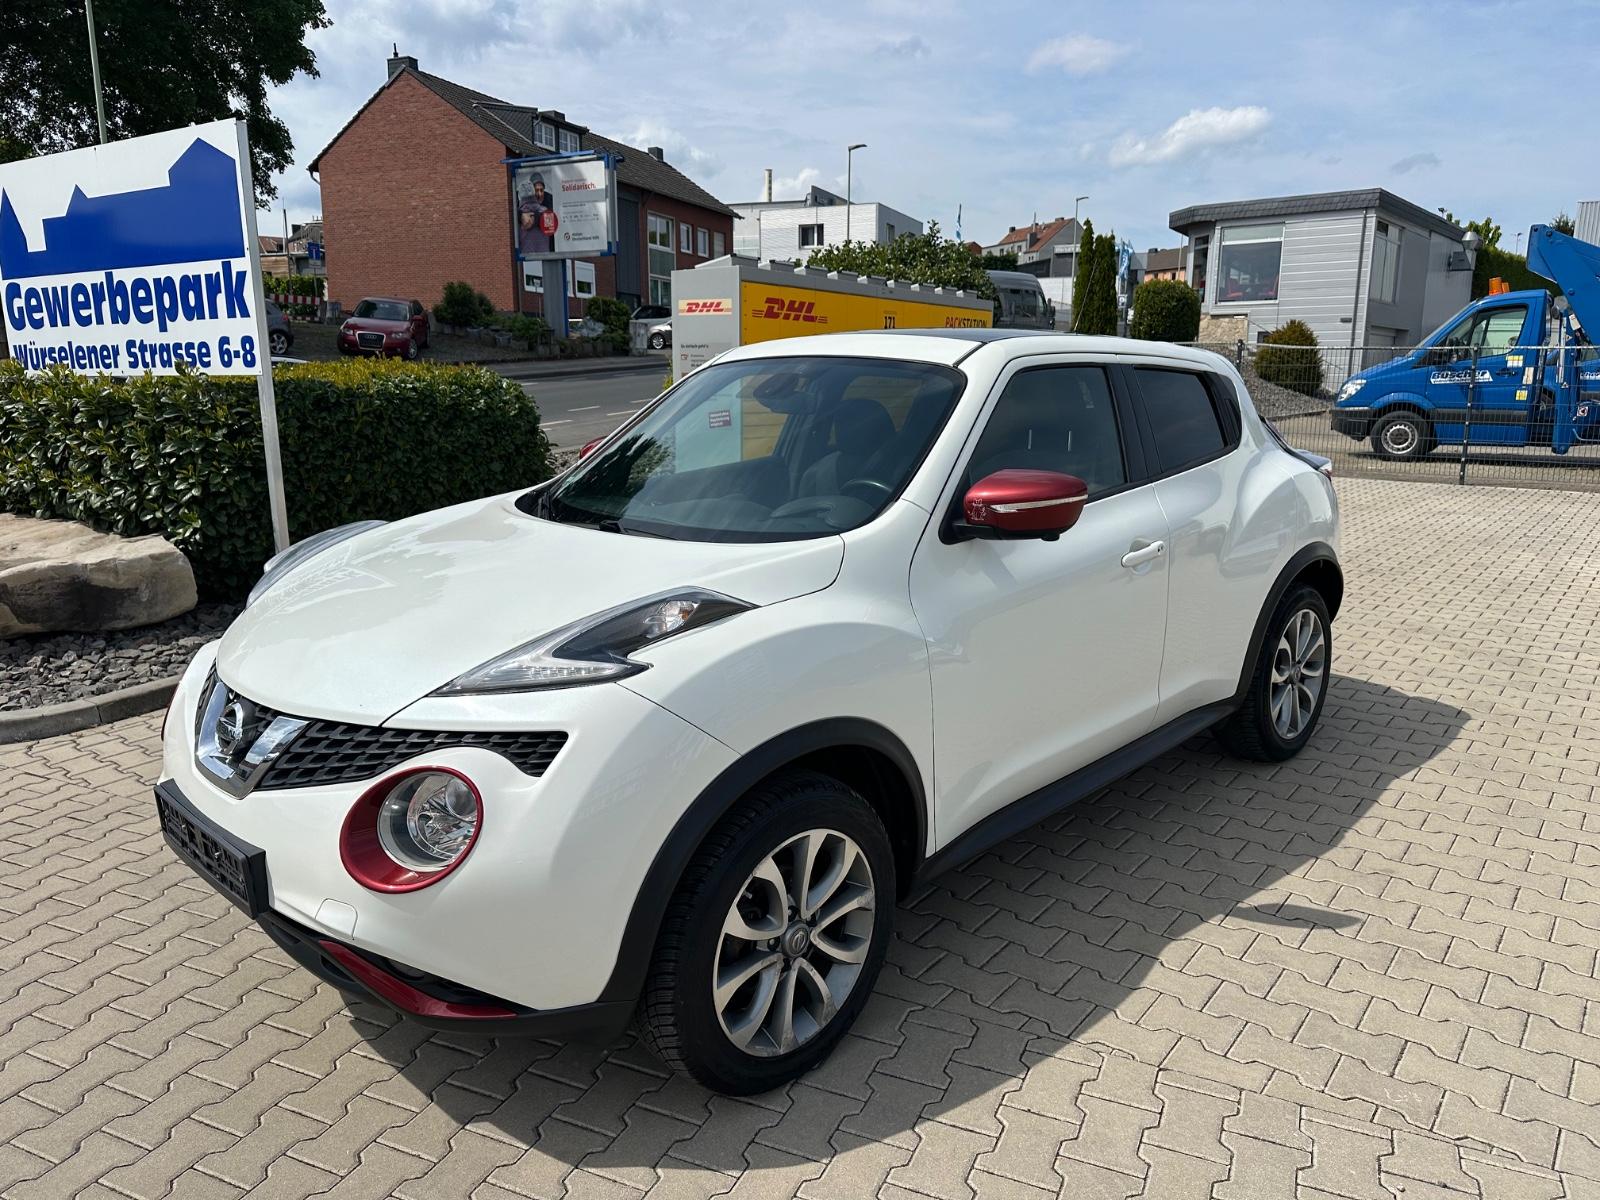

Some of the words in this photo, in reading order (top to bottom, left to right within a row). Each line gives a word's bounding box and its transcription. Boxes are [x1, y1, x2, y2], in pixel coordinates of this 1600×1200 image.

[562, 182, 596, 192] Solidarisch.
[5, 260, 251, 333] Gewerbepark
[686, 301, 724, 313] DHL
[764, 297, 818, 323] DHL
[884, 316, 896, 329] 171
[945, 316, 988, 329] PACKSTATION
[13, 341, 121, 371] Würselener
[126, 338, 212, 369] Strasse
[218, 335, 256, 368] 6-8
